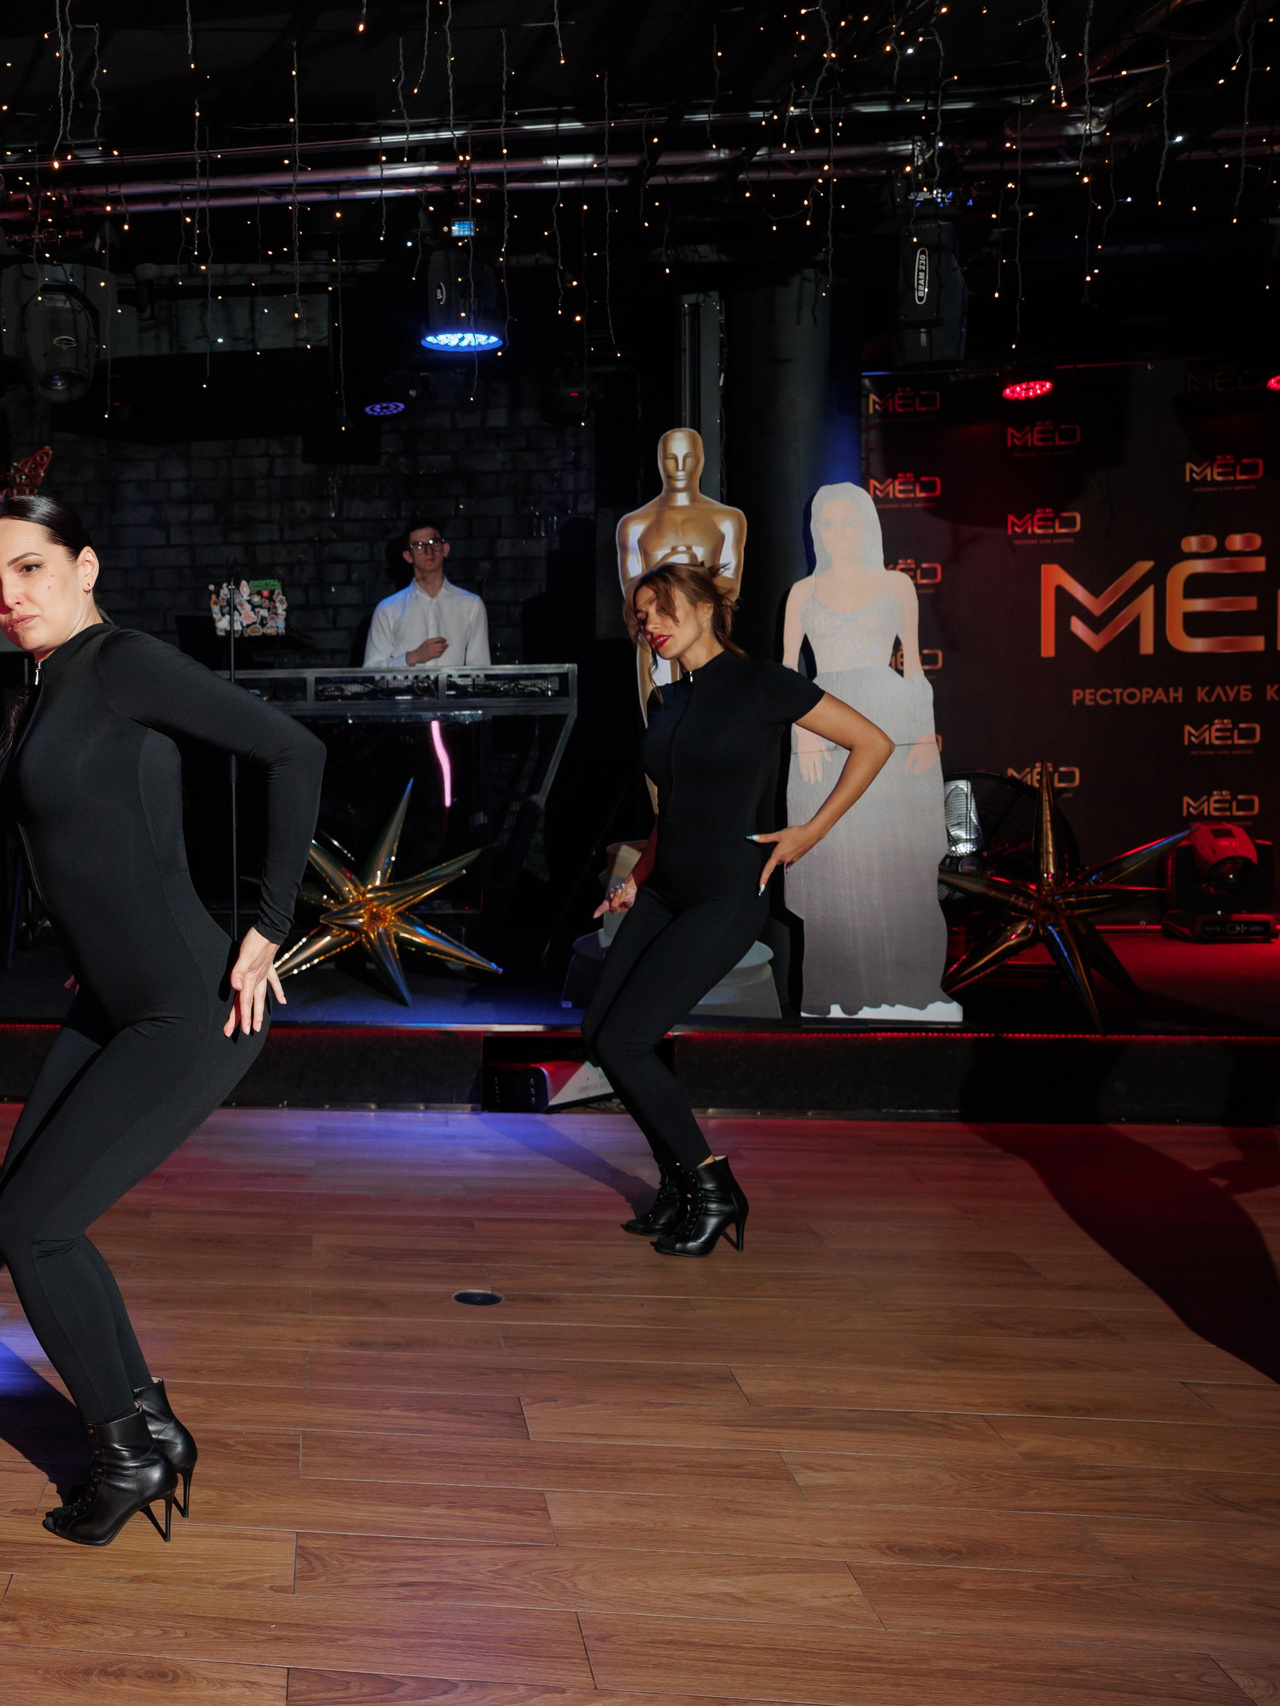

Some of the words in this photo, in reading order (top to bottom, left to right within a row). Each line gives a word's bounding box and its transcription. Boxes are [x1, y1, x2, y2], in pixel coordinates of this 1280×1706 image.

[1041, 532, 1280, 658] МЁ
[1072, 686, 1183, 706] РЕСТОРАН
[1196, 684, 1252, 703] КЛУБ
